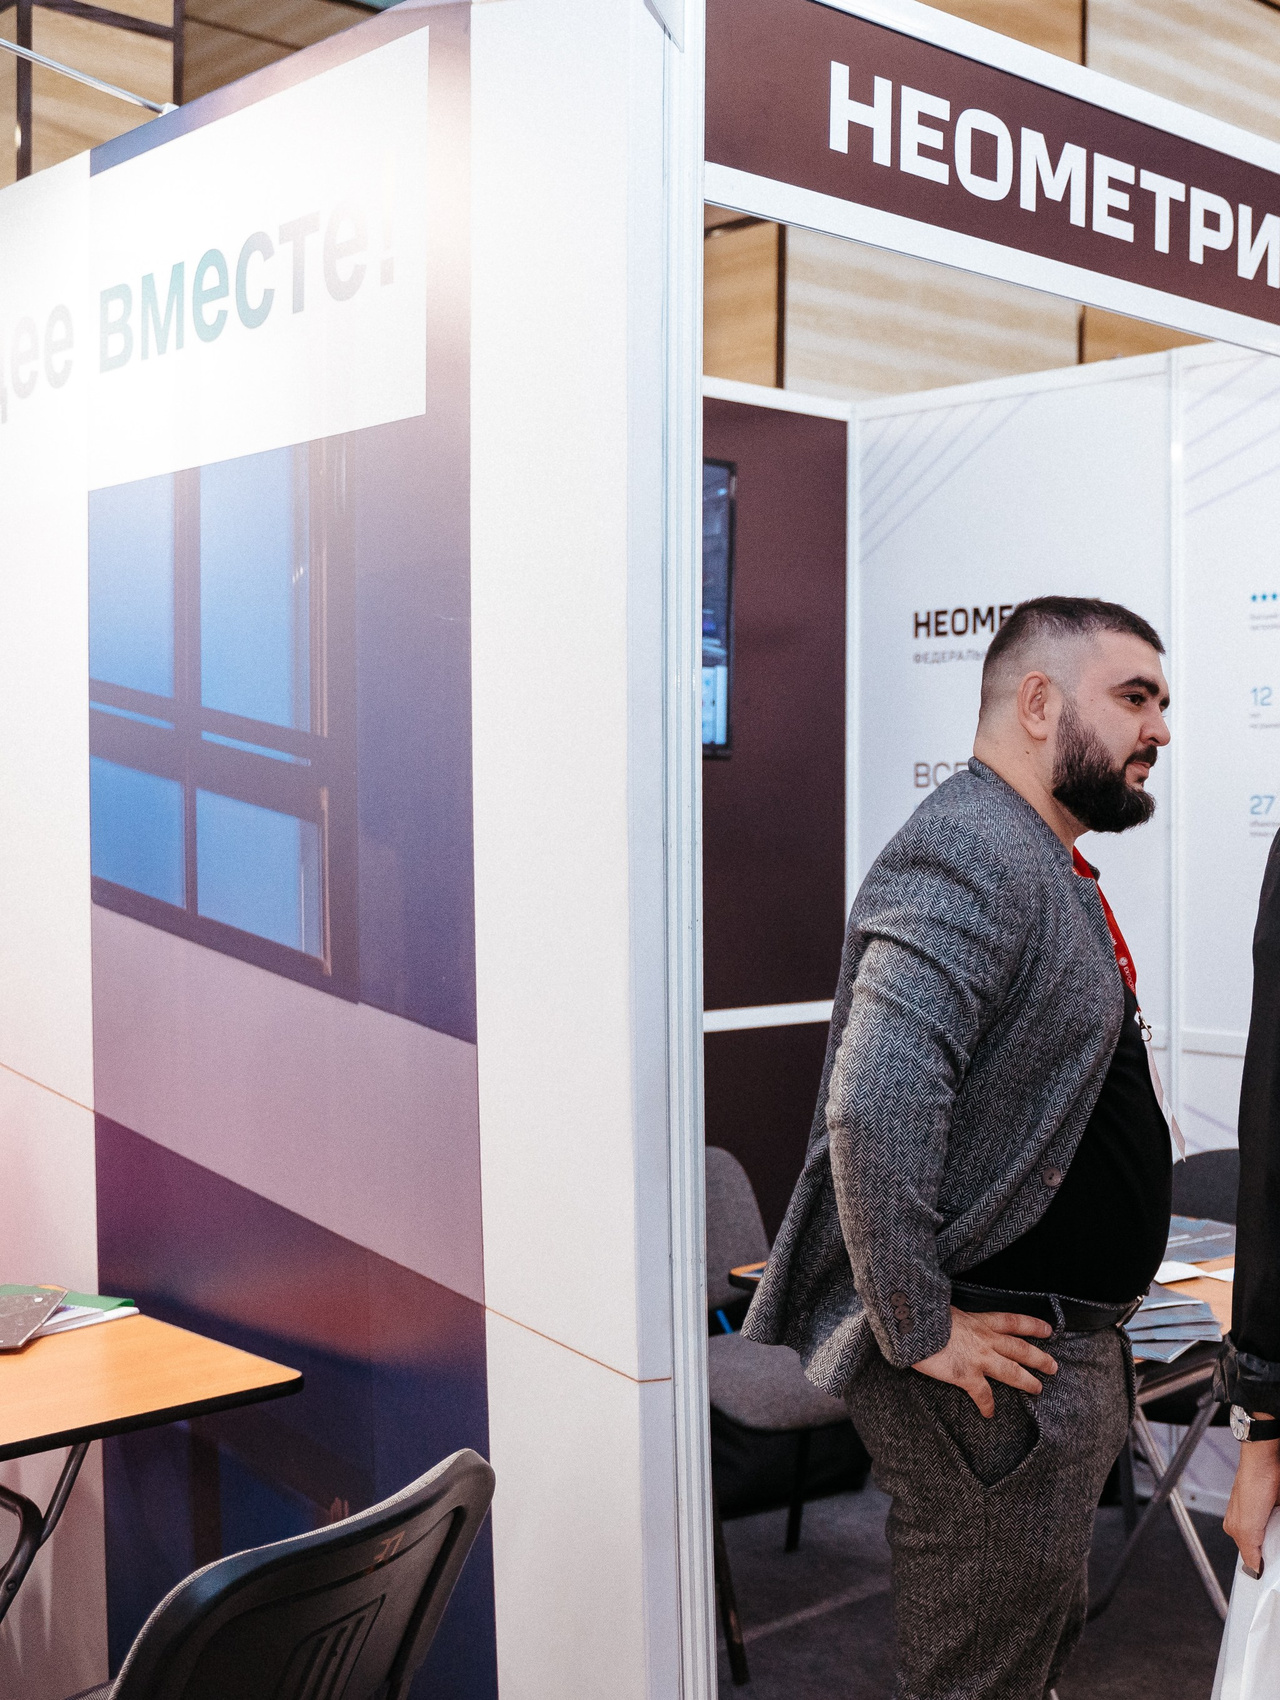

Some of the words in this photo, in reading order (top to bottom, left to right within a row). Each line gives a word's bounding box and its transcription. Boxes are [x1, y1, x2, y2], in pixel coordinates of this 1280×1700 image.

[99, 150, 396, 374] вместе!
[1251, 686, 1273, 707] 12
[1249, 793, 1277, 816] 27
